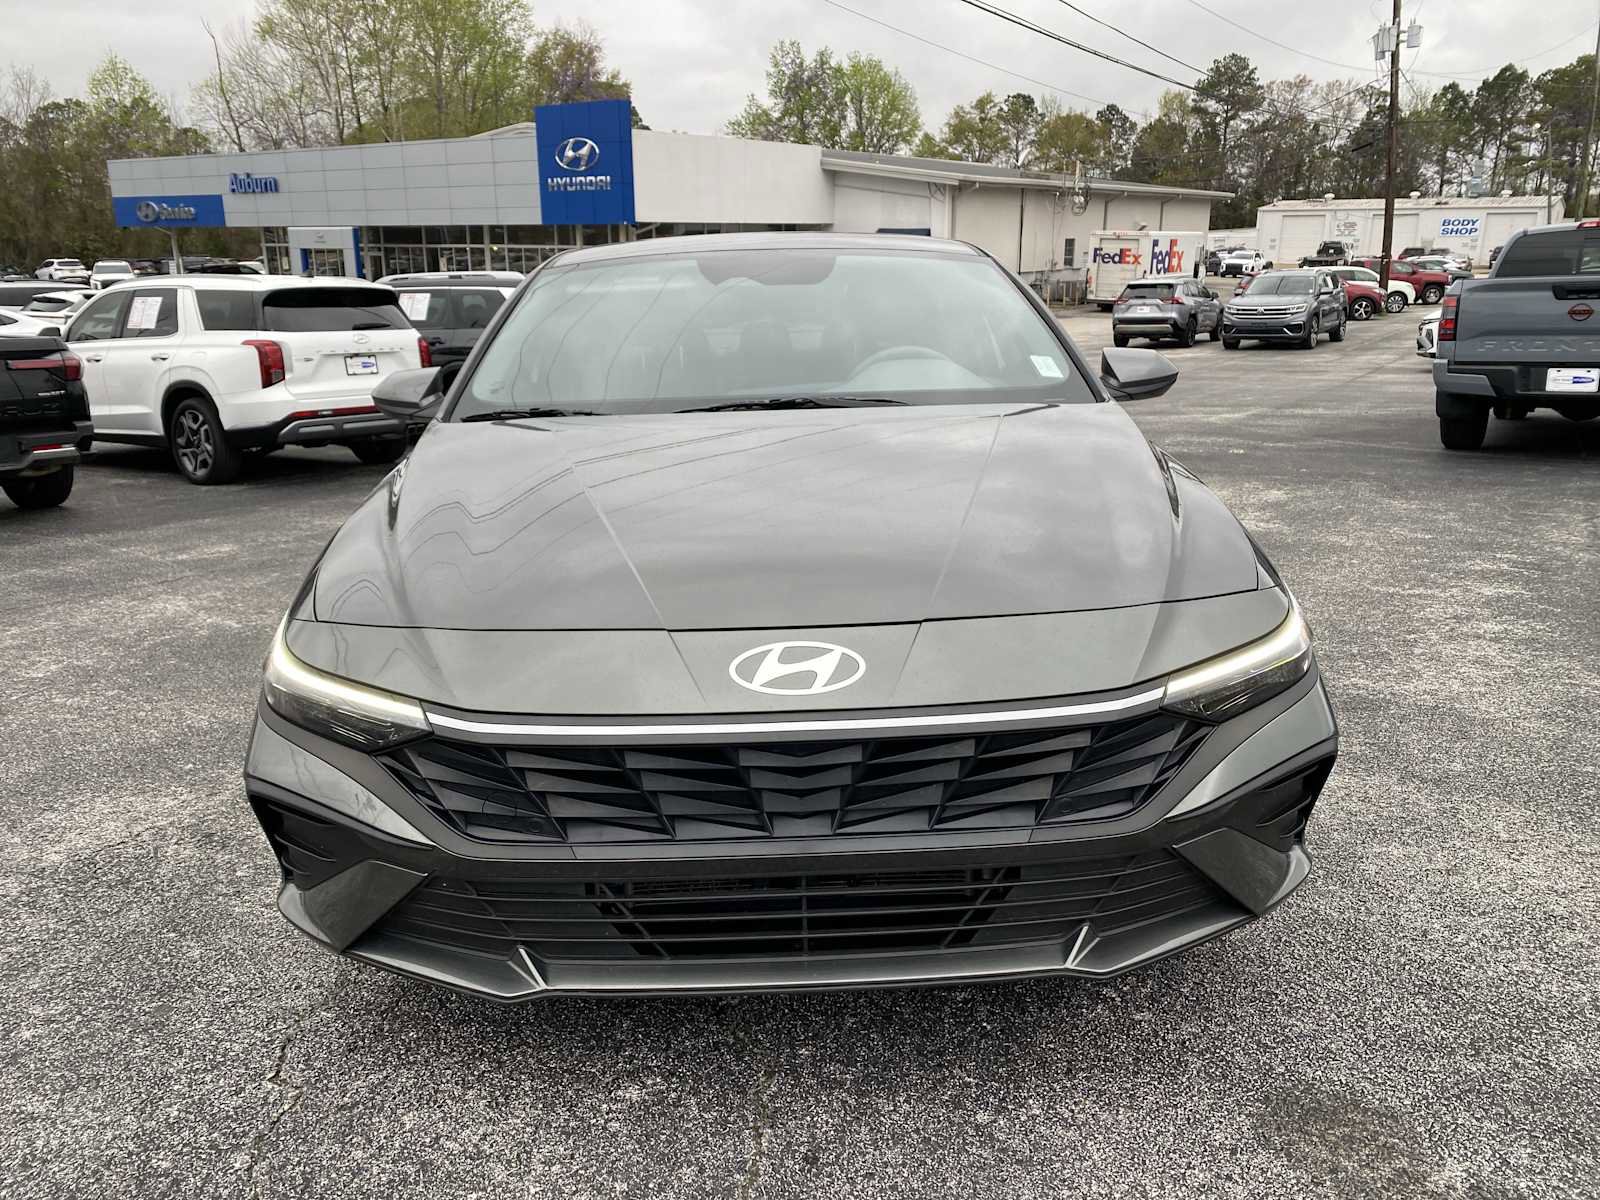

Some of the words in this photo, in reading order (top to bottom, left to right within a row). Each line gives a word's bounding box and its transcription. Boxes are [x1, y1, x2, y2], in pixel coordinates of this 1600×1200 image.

[229, 172, 279, 193] Auburn
[547, 175, 611, 192] HYUNDAI
[1440, 227, 1478, 235] SHOP
[1441, 218, 1479, 227] BODY
[1093, 247, 1142, 265] FedEx
[1150, 239, 1184, 275] FedEx
